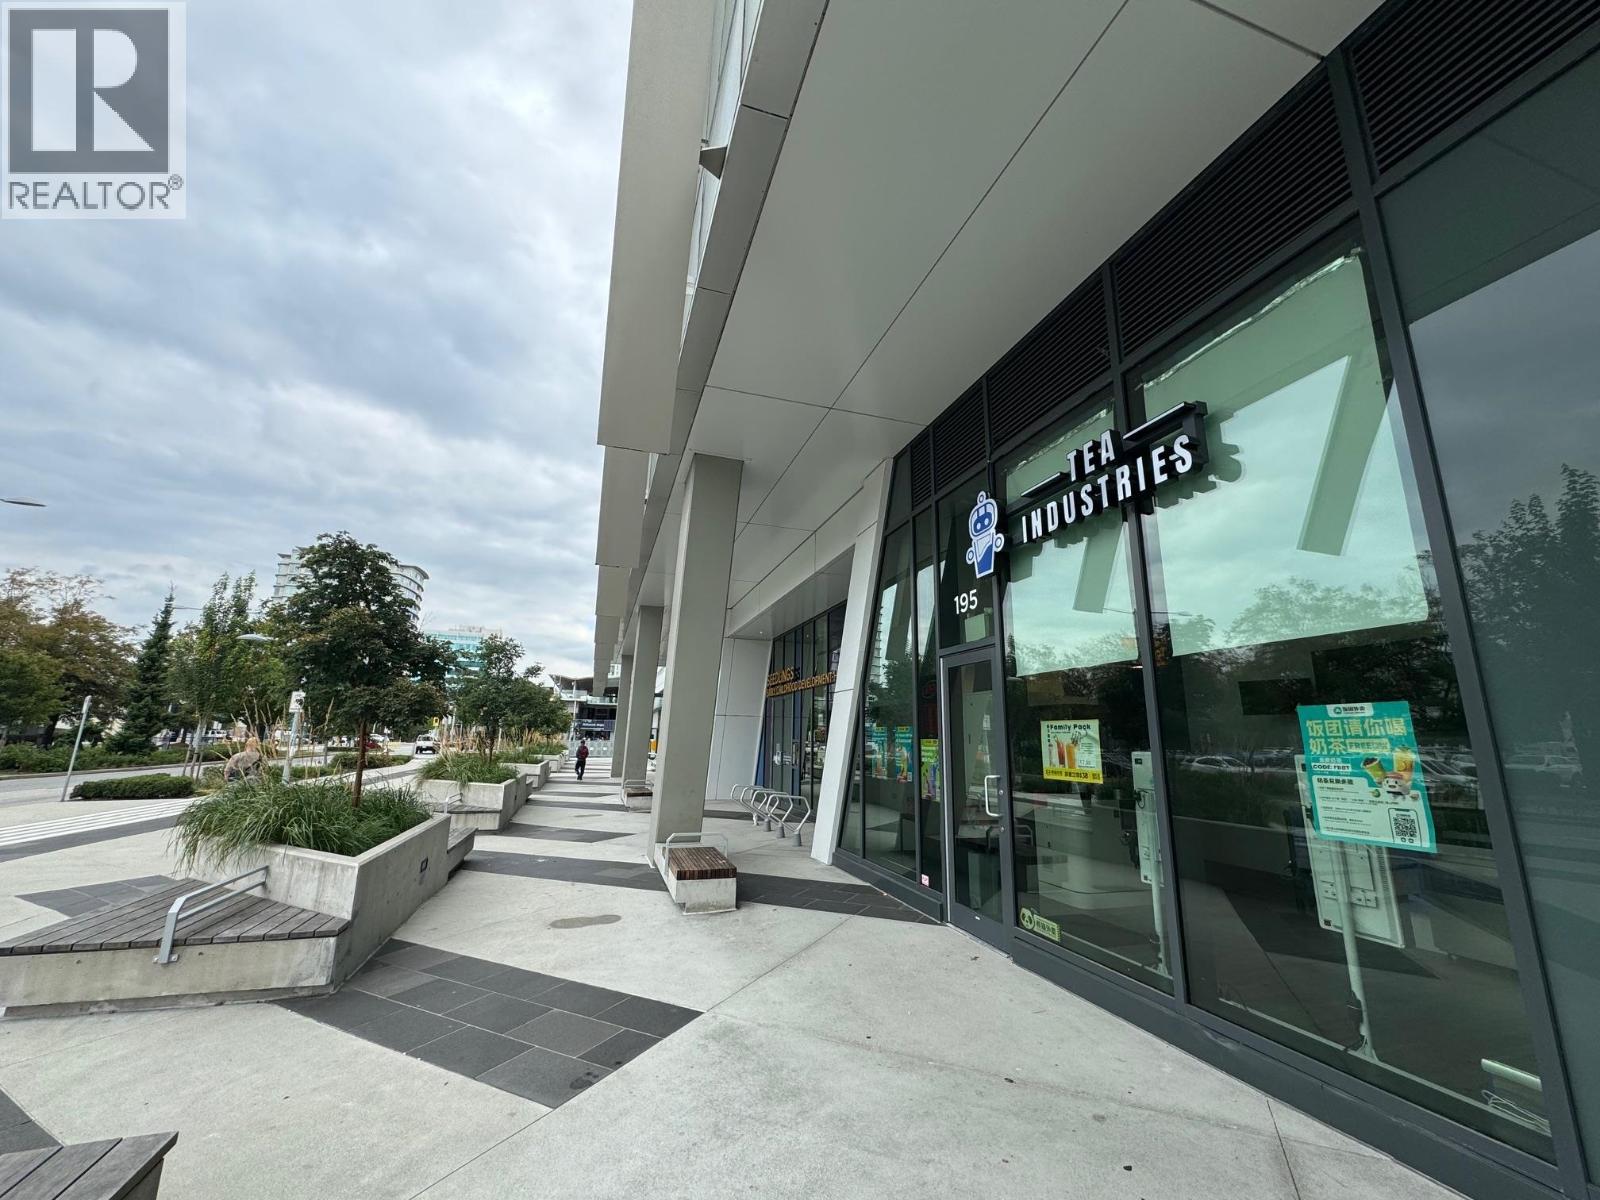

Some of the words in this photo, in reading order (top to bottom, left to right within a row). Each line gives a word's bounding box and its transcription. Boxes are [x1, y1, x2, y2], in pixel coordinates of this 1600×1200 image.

[1066, 429, 1116, 482] TEA
[1021, 434, 1193, 543] INDUSTRIES
[953, 589, 978, 615] 195
[1306, 718, 1407, 736] 饭团请你喝
[1309, 737, 1347, 755] 奶茶
